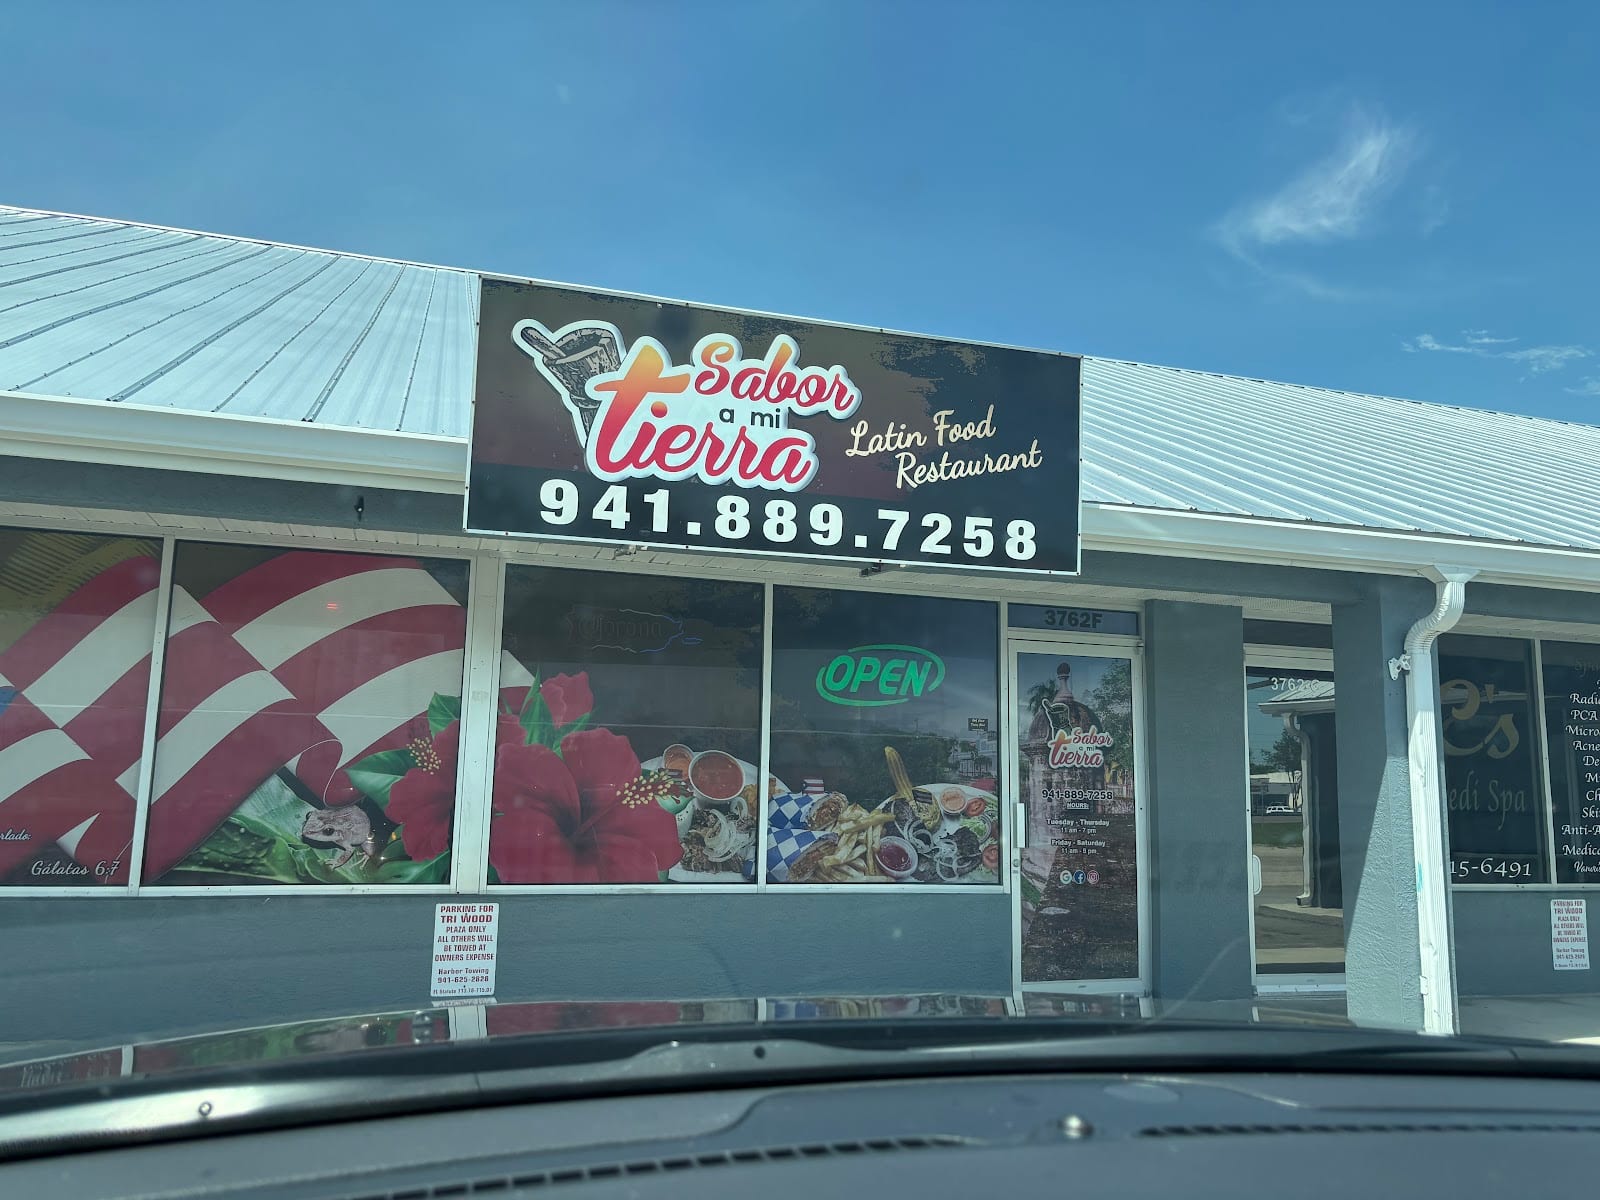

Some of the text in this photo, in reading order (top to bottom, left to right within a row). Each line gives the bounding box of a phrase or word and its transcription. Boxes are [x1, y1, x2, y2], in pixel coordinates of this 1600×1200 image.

[694, 341, 855, 410] Sabor
[595, 345, 813, 484] tierra
[719, 407, 781, 429] a mi
[846, 404, 996, 458] Latin Food
[896, 440, 1043, 489] Restaurant
[539, 479, 1038, 560] 941.889.7258
[1044, 609, 1103, 629] 3762F
[825, 655, 932, 697] OPEN
[1570, 692, 1600, 705] Radi
[1571, 710, 1598, 720] PCA
[1073, 727, 1112, 746] Sabor
[1566, 724, 1600, 736] Micro
[1050, 731, 1102, 766] tierra
[1573, 740, 1600, 751] Acne
[1583, 756, 1600, 766] De
[1042, 789, 1113, 800] 941-889-7258
[1449, 770, 1526, 830] edi Spa
[1586, 788, 1600, 801] Ch
[1582, 805, 1600, 818] Ski
[1047, 819, 1074, 827] Tuesday
[1080, 819, 1110, 827] Thursday
[0, 829, 32, 840] rlado:
[1562, 825, 1600, 835] Anti-A
[1051, 840, 1072, 848] Friday
[1077, 840, 1106, 848] Saturday
[31, 860, 120, 875] Gálatas 6:7
[1450, 858, 1532, 878] 15-6491
[441, 915, 492, 923] TRI WOOD
[438, 935, 448, 943] ALL
